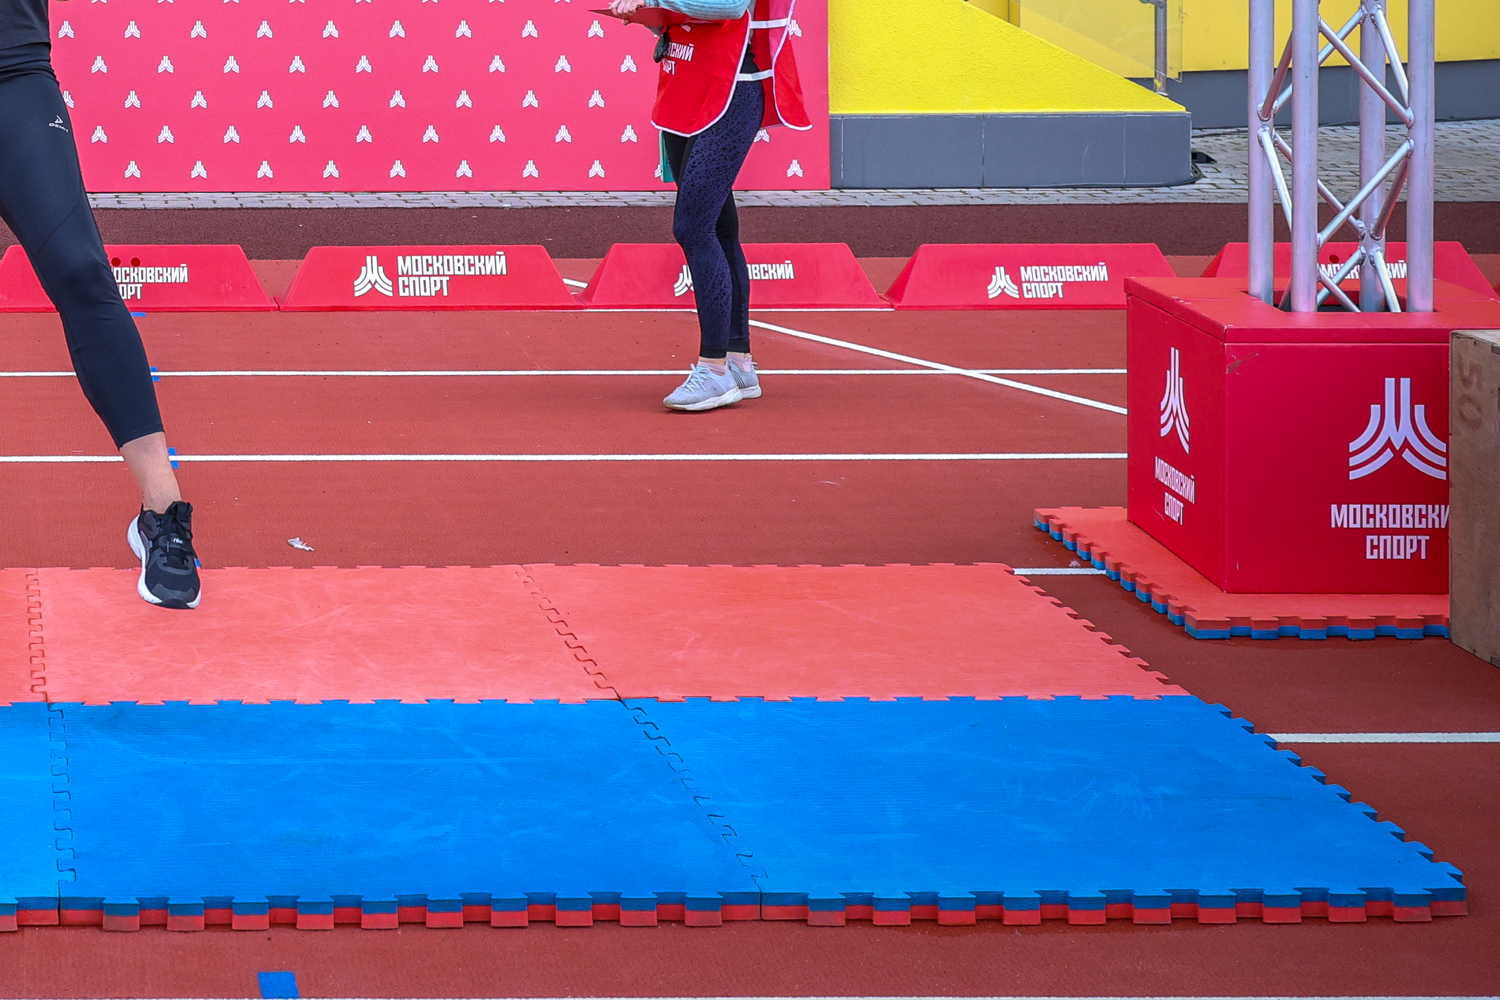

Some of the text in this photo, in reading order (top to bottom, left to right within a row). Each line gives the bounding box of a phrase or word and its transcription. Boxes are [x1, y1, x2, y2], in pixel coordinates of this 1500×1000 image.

[111, 263, 189, 283] ОСКОВСКИЙ
[397, 251, 508, 275] МОСКОВСКИЙ
[1020, 261, 1109, 282] МОСКОВСКИЙ
[117, 283, 143, 300] ОРТ
[398, 276, 450, 297] СПОРТ
[1022, 282, 1064, 298] СПОРТ
[1154, 456, 1196, 504] МОСКОВСКИЙ
[1163, 491, 1184, 525] СПОРТ
[1330, 504, 1450, 528] МОСКОВСКИ
[1366, 535, 1430, 560] СПОРТ
